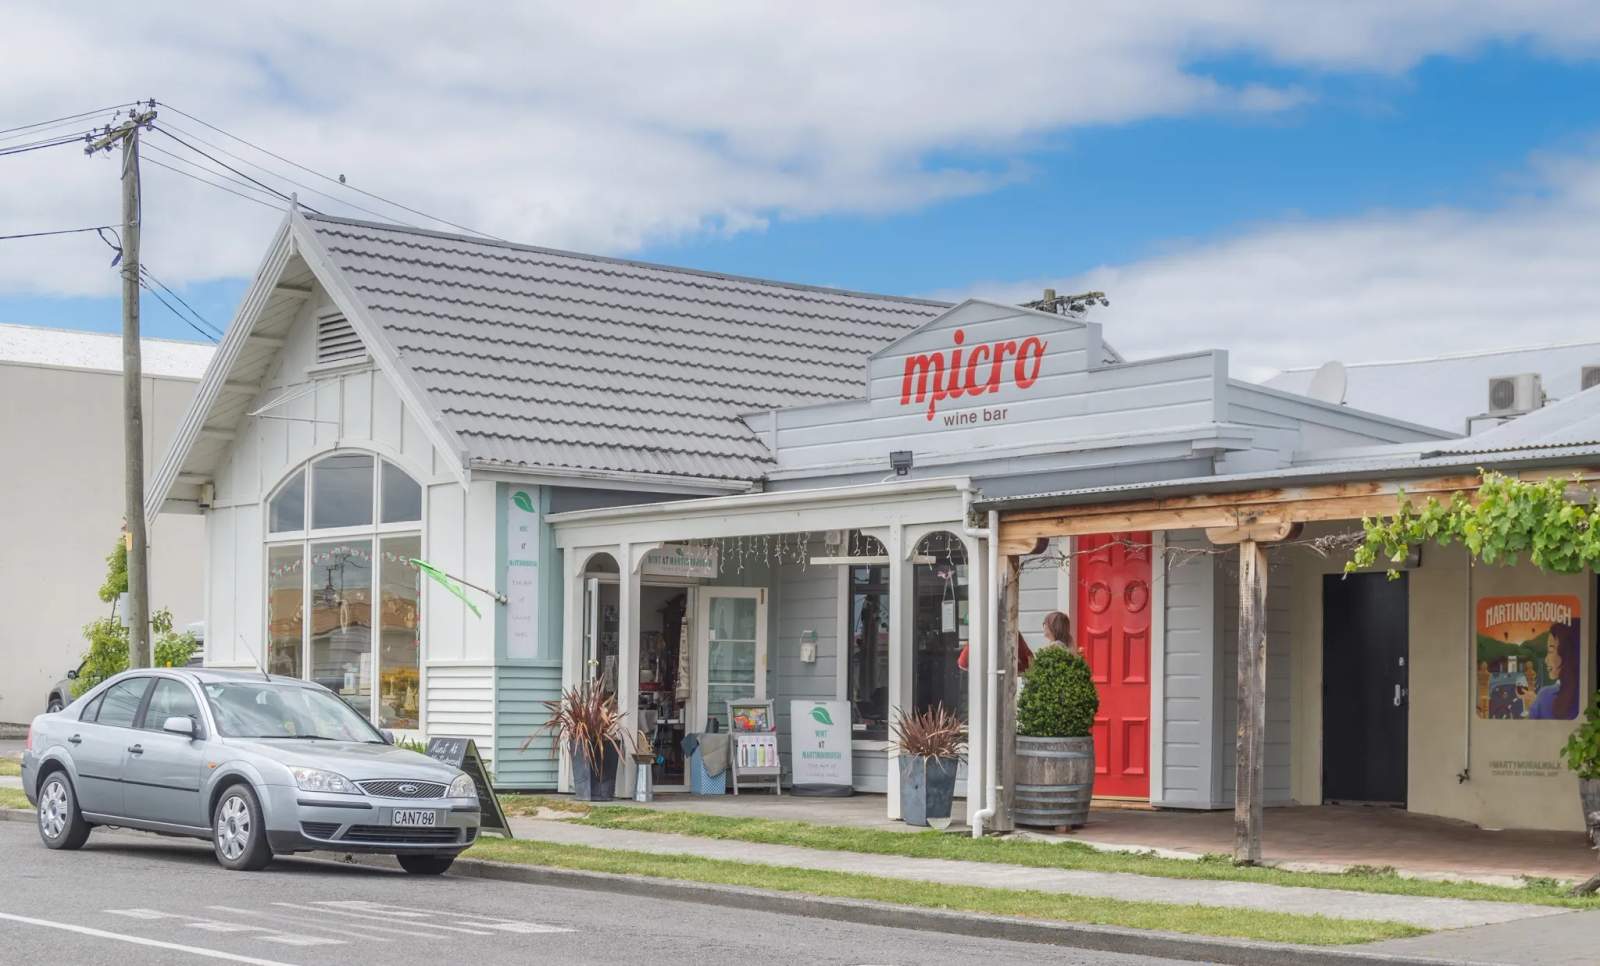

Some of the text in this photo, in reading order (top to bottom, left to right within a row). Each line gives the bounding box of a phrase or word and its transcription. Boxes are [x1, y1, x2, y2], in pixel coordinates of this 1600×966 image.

[900, 329, 1048, 421] micro
[944, 408, 1008, 426] wine bar
[1485, 601, 1572, 627] MARTINBOROUGH
[394, 811, 435, 826] CAN780
